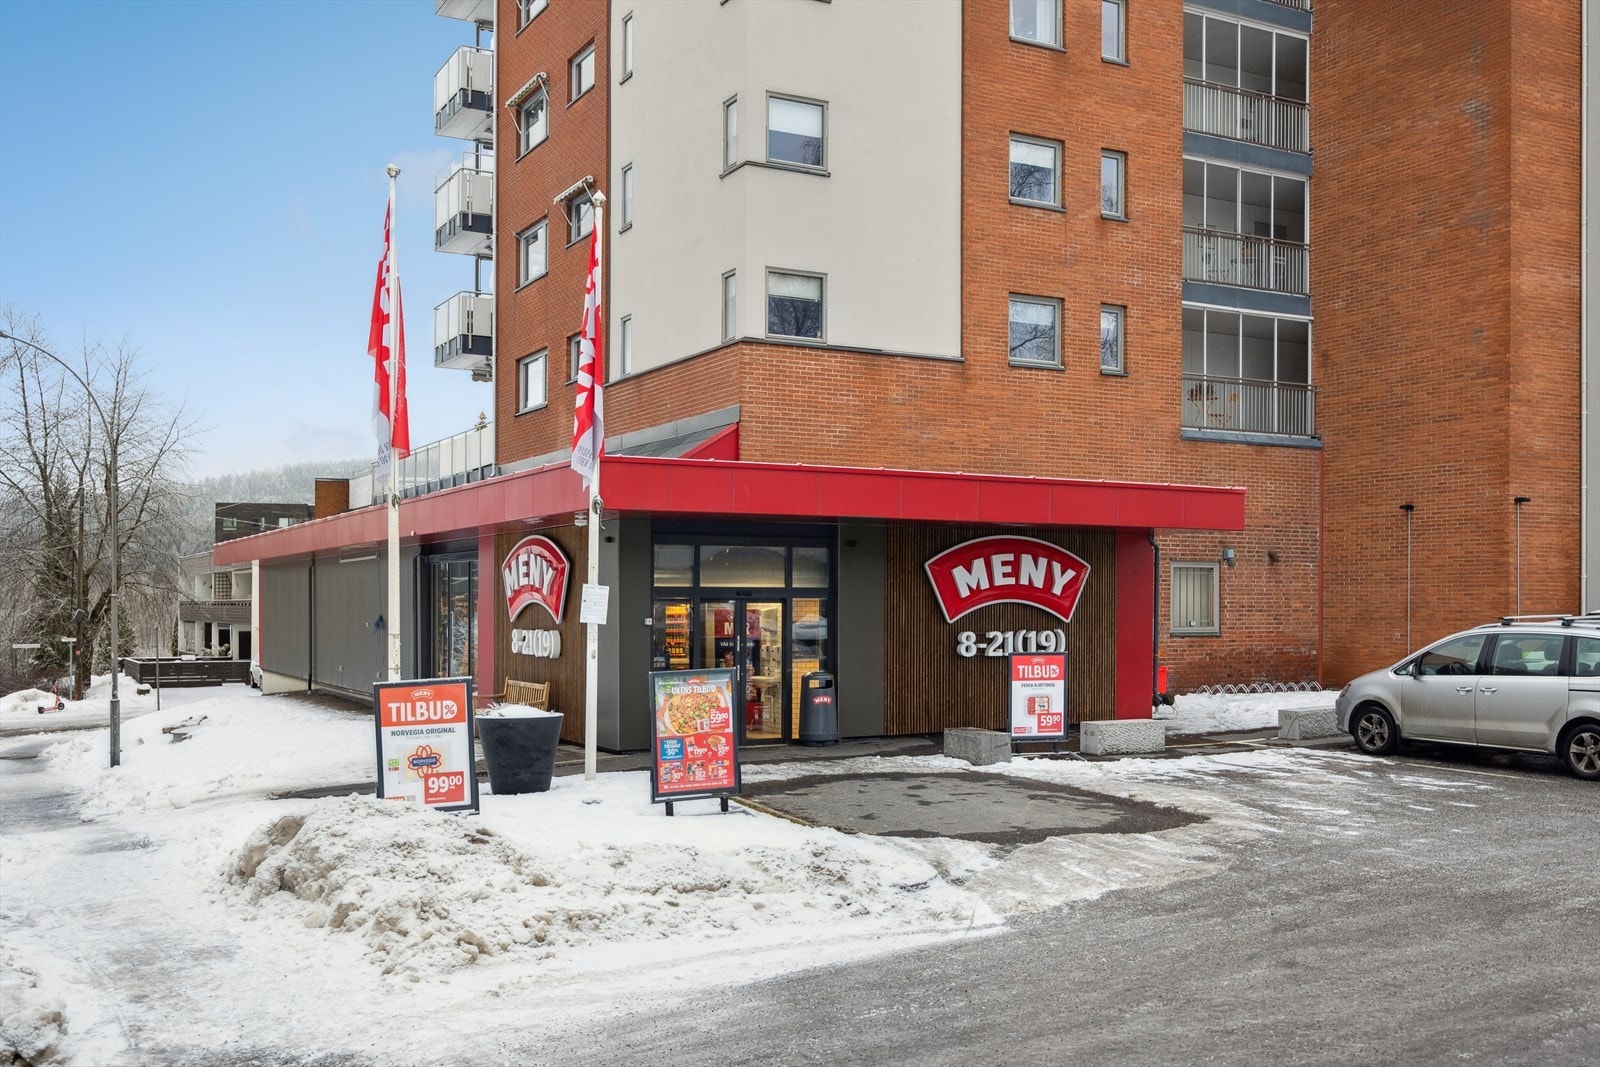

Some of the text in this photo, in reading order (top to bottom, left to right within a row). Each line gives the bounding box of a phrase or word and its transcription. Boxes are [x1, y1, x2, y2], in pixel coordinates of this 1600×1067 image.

[505, 553, 555, 598] MENY
[951, 553, 1076, 598] MENY
[511, 628, 561, 659] 8-21(19)
[957, 628, 1067, 659] 8-21(19)
[671, 684, 717, 695] UKENS TILBUD
[814, 696, 831, 704] MENY
[390, 726, 456, 737] NORVEGIA ORIGINAL
